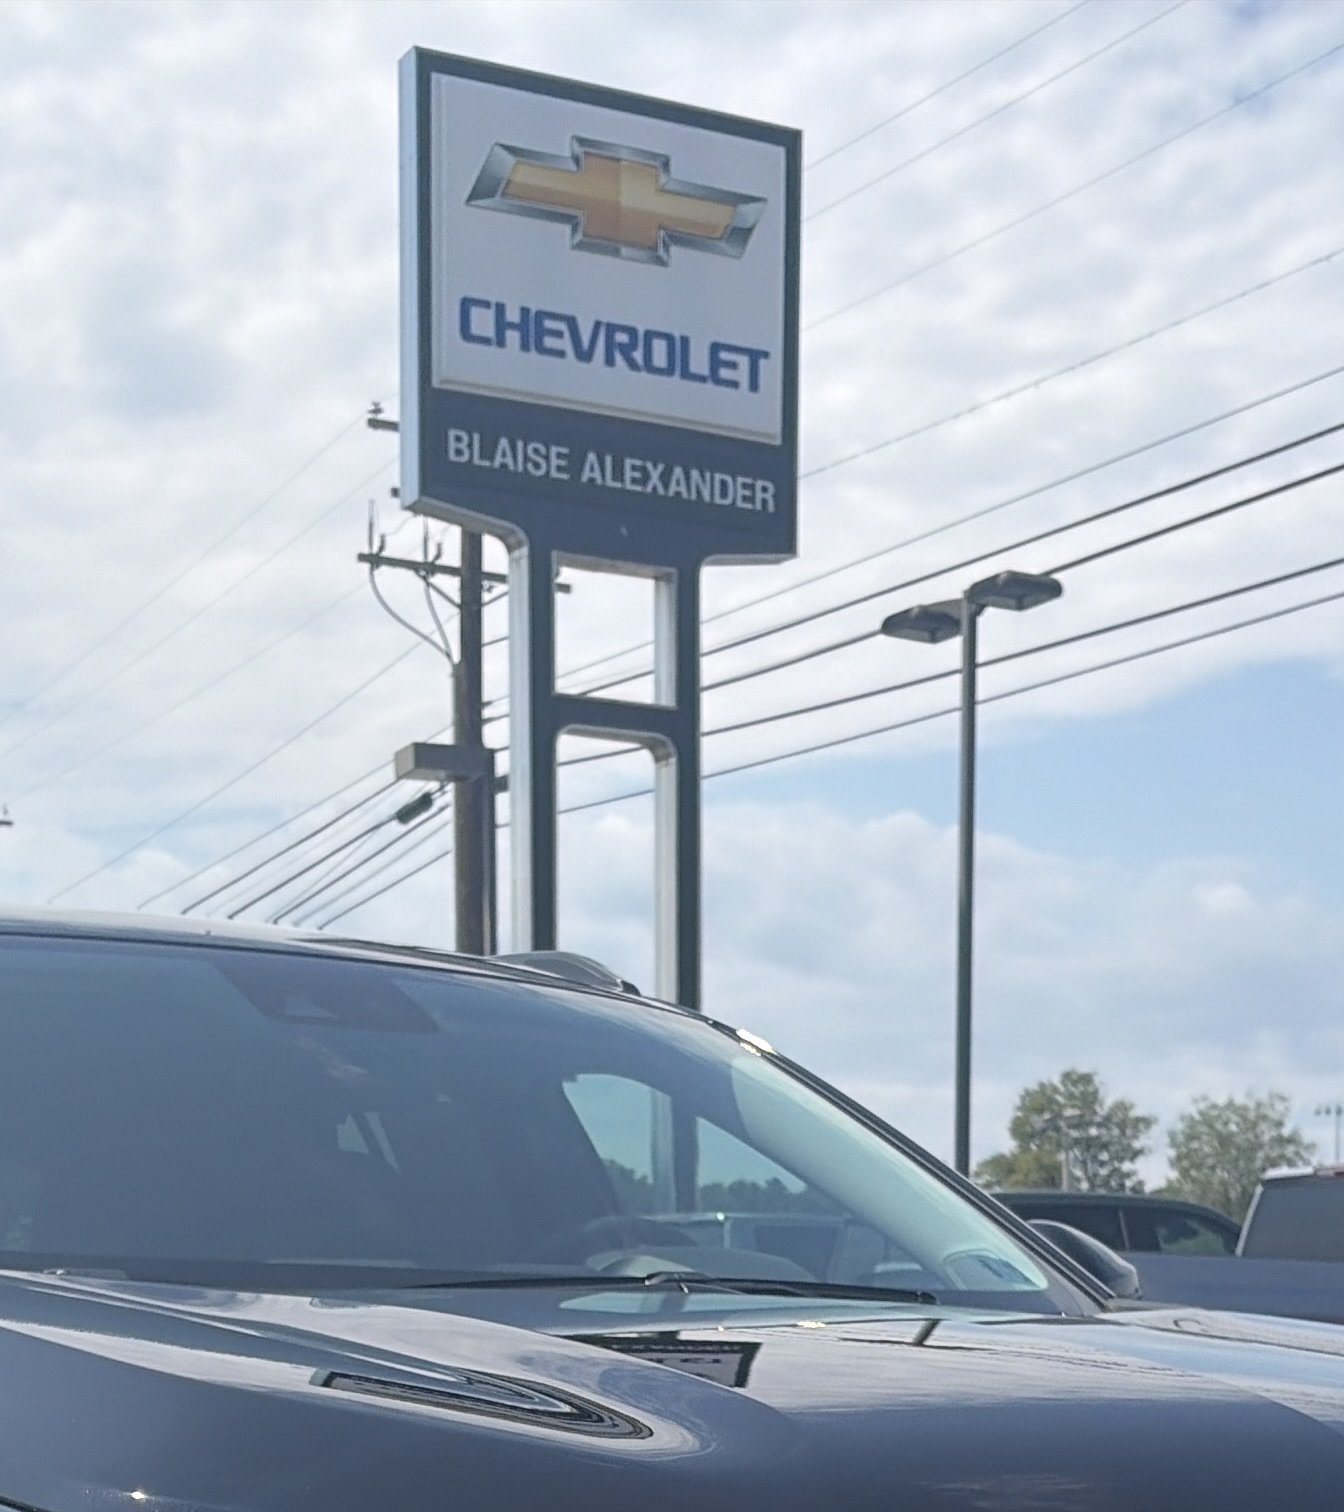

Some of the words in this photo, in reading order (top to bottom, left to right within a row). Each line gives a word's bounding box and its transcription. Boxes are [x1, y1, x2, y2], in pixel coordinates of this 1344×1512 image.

[459, 295, 771, 393] CHEVROLET
[446, 428, 571, 480] BLAISE
[580, 450, 776, 513] ALEXANDER
